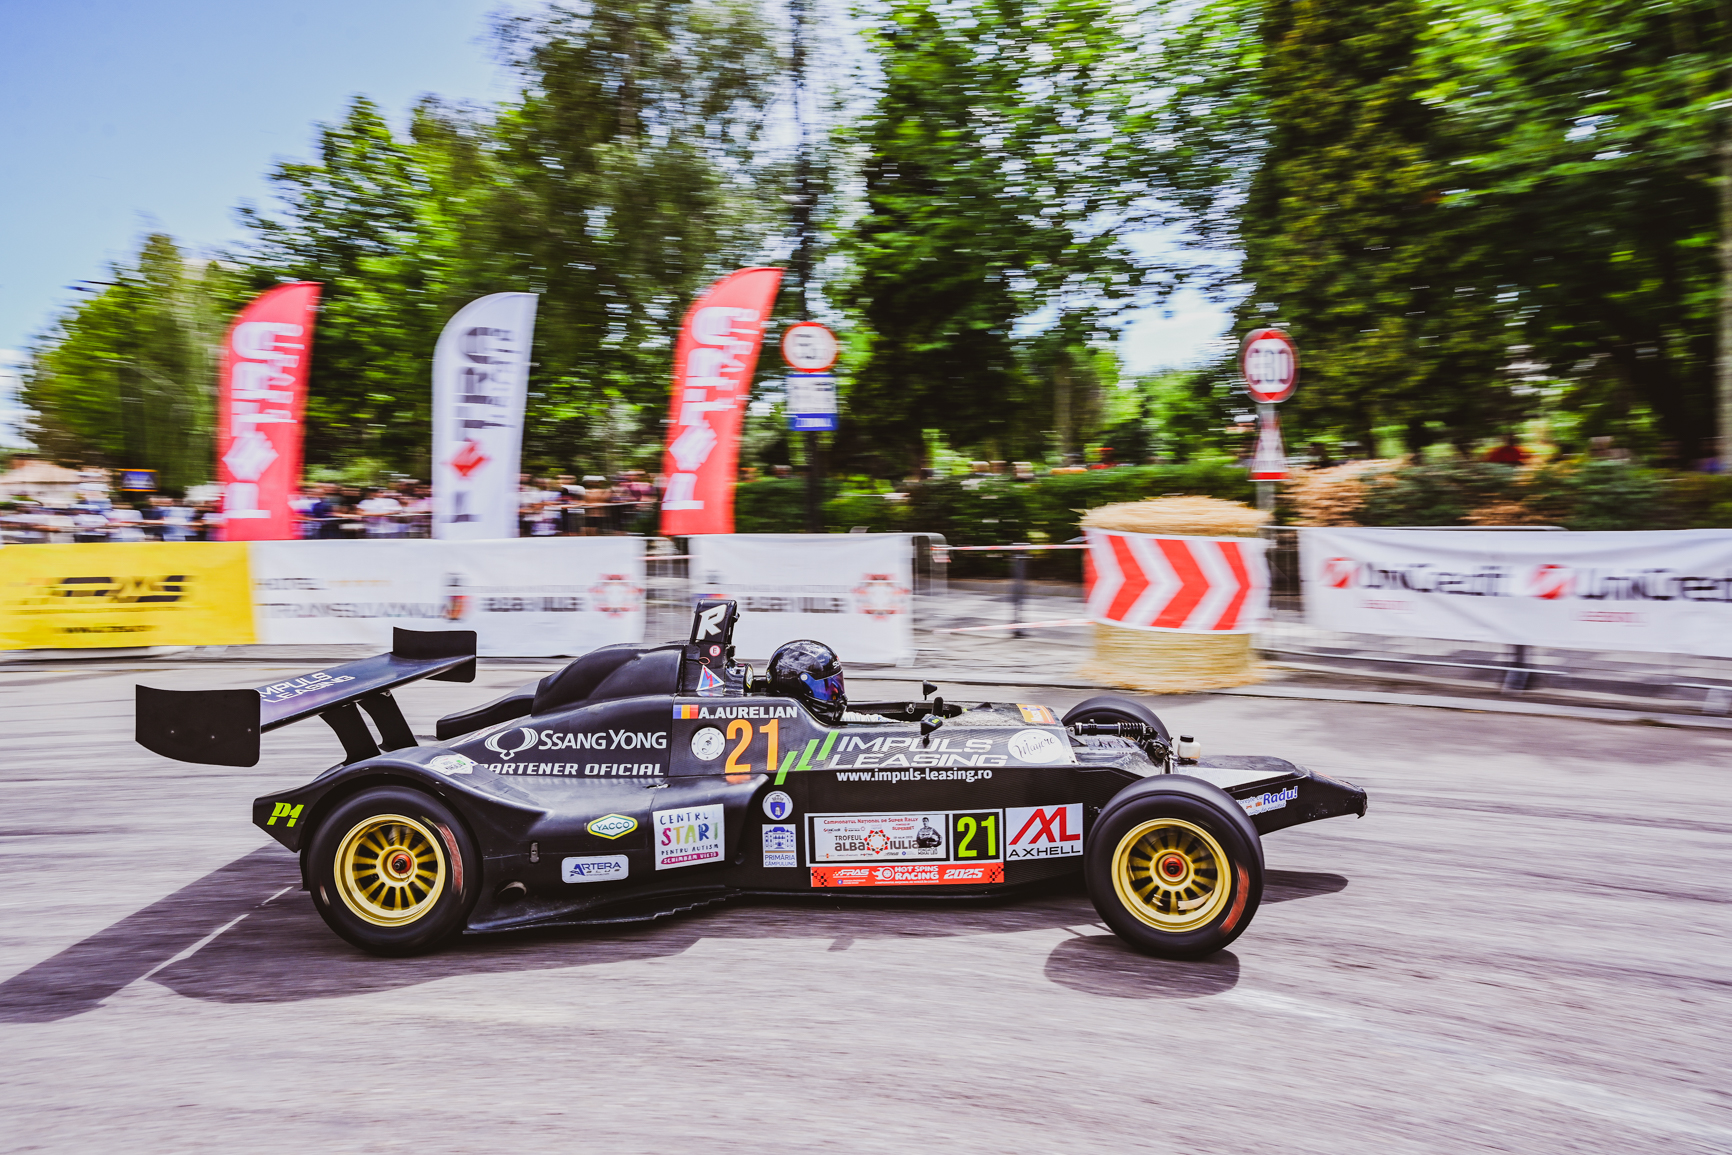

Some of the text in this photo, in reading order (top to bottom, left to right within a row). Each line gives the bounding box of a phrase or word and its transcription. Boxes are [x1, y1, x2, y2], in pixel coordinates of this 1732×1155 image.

[696, 604, 727, 640] R
[698, 706, 798, 719] A.AURELIAN
[725, 719, 778, 774] 21
[837, 736, 993, 753] IMPULS
[828, 753, 1008, 768] LEASING
[584, 763, 664, 775] OFICIAL
[836, 767, 993, 783] www.impuls-leasing.ro
[1263, 786, 1298, 805] Radu!
[266, 802, 305, 828] P1
[596, 821, 630, 832] YACCO
[661, 822, 718, 846] START
[957, 815, 996, 858] 21
[661, 843, 719, 856] PENTRU AUTISM
[1008, 845, 1081, 858] AXHELL
[571, 862, 622, 877] ARTERA
[894, 871, 939, 880] RACING
[943, 868, 984, 879] 2025
